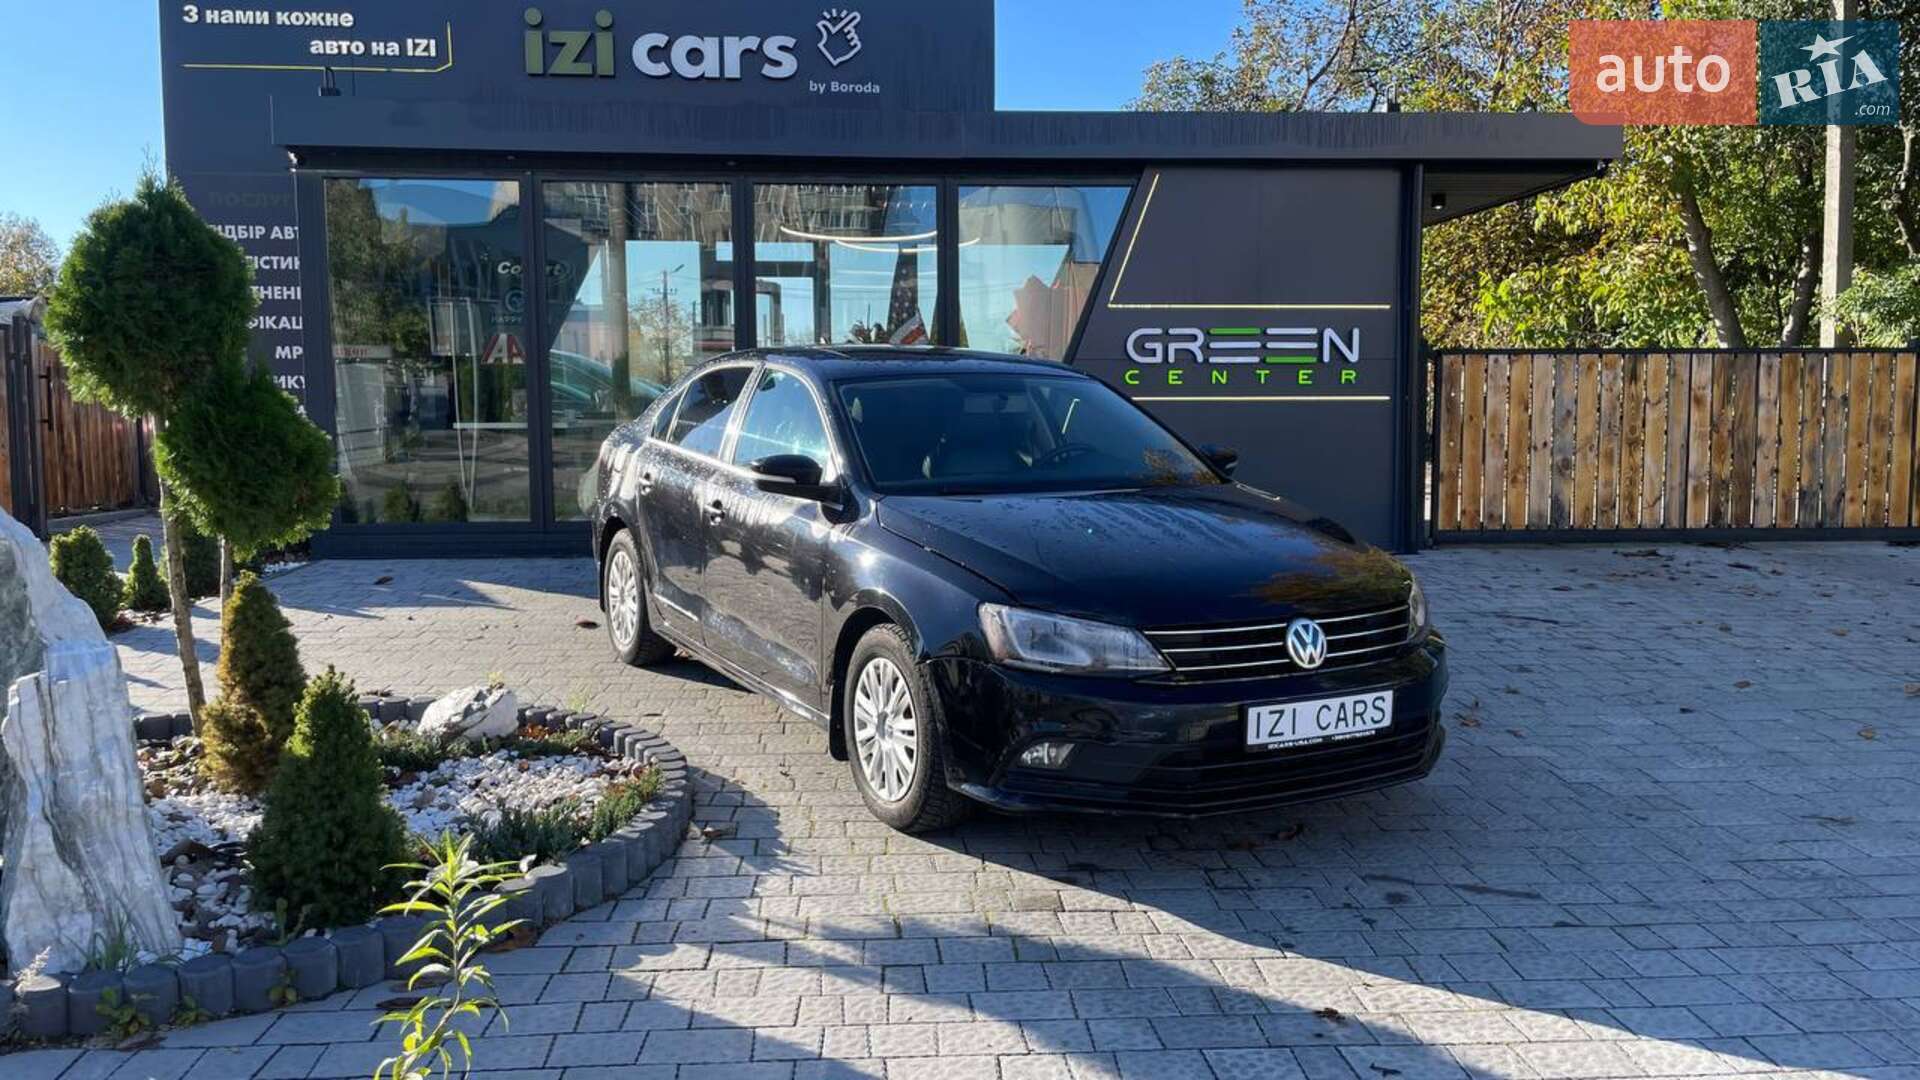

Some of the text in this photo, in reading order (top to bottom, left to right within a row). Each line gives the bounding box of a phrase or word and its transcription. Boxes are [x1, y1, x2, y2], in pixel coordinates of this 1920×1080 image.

[182, 5, 354, 28] З нами кожне
[309, 38, 437, 58] авто на IZI
[523, 8, 799, 79] izi cars
[809, 80, 881, 95] by Boroda
[1126, 327, 1360, 364] GREEN
[1124, 369, 1357, 385] CENTER
[1255, 707, 1297, 740] IZI
[1316, 695, 1386, 731] CARS
